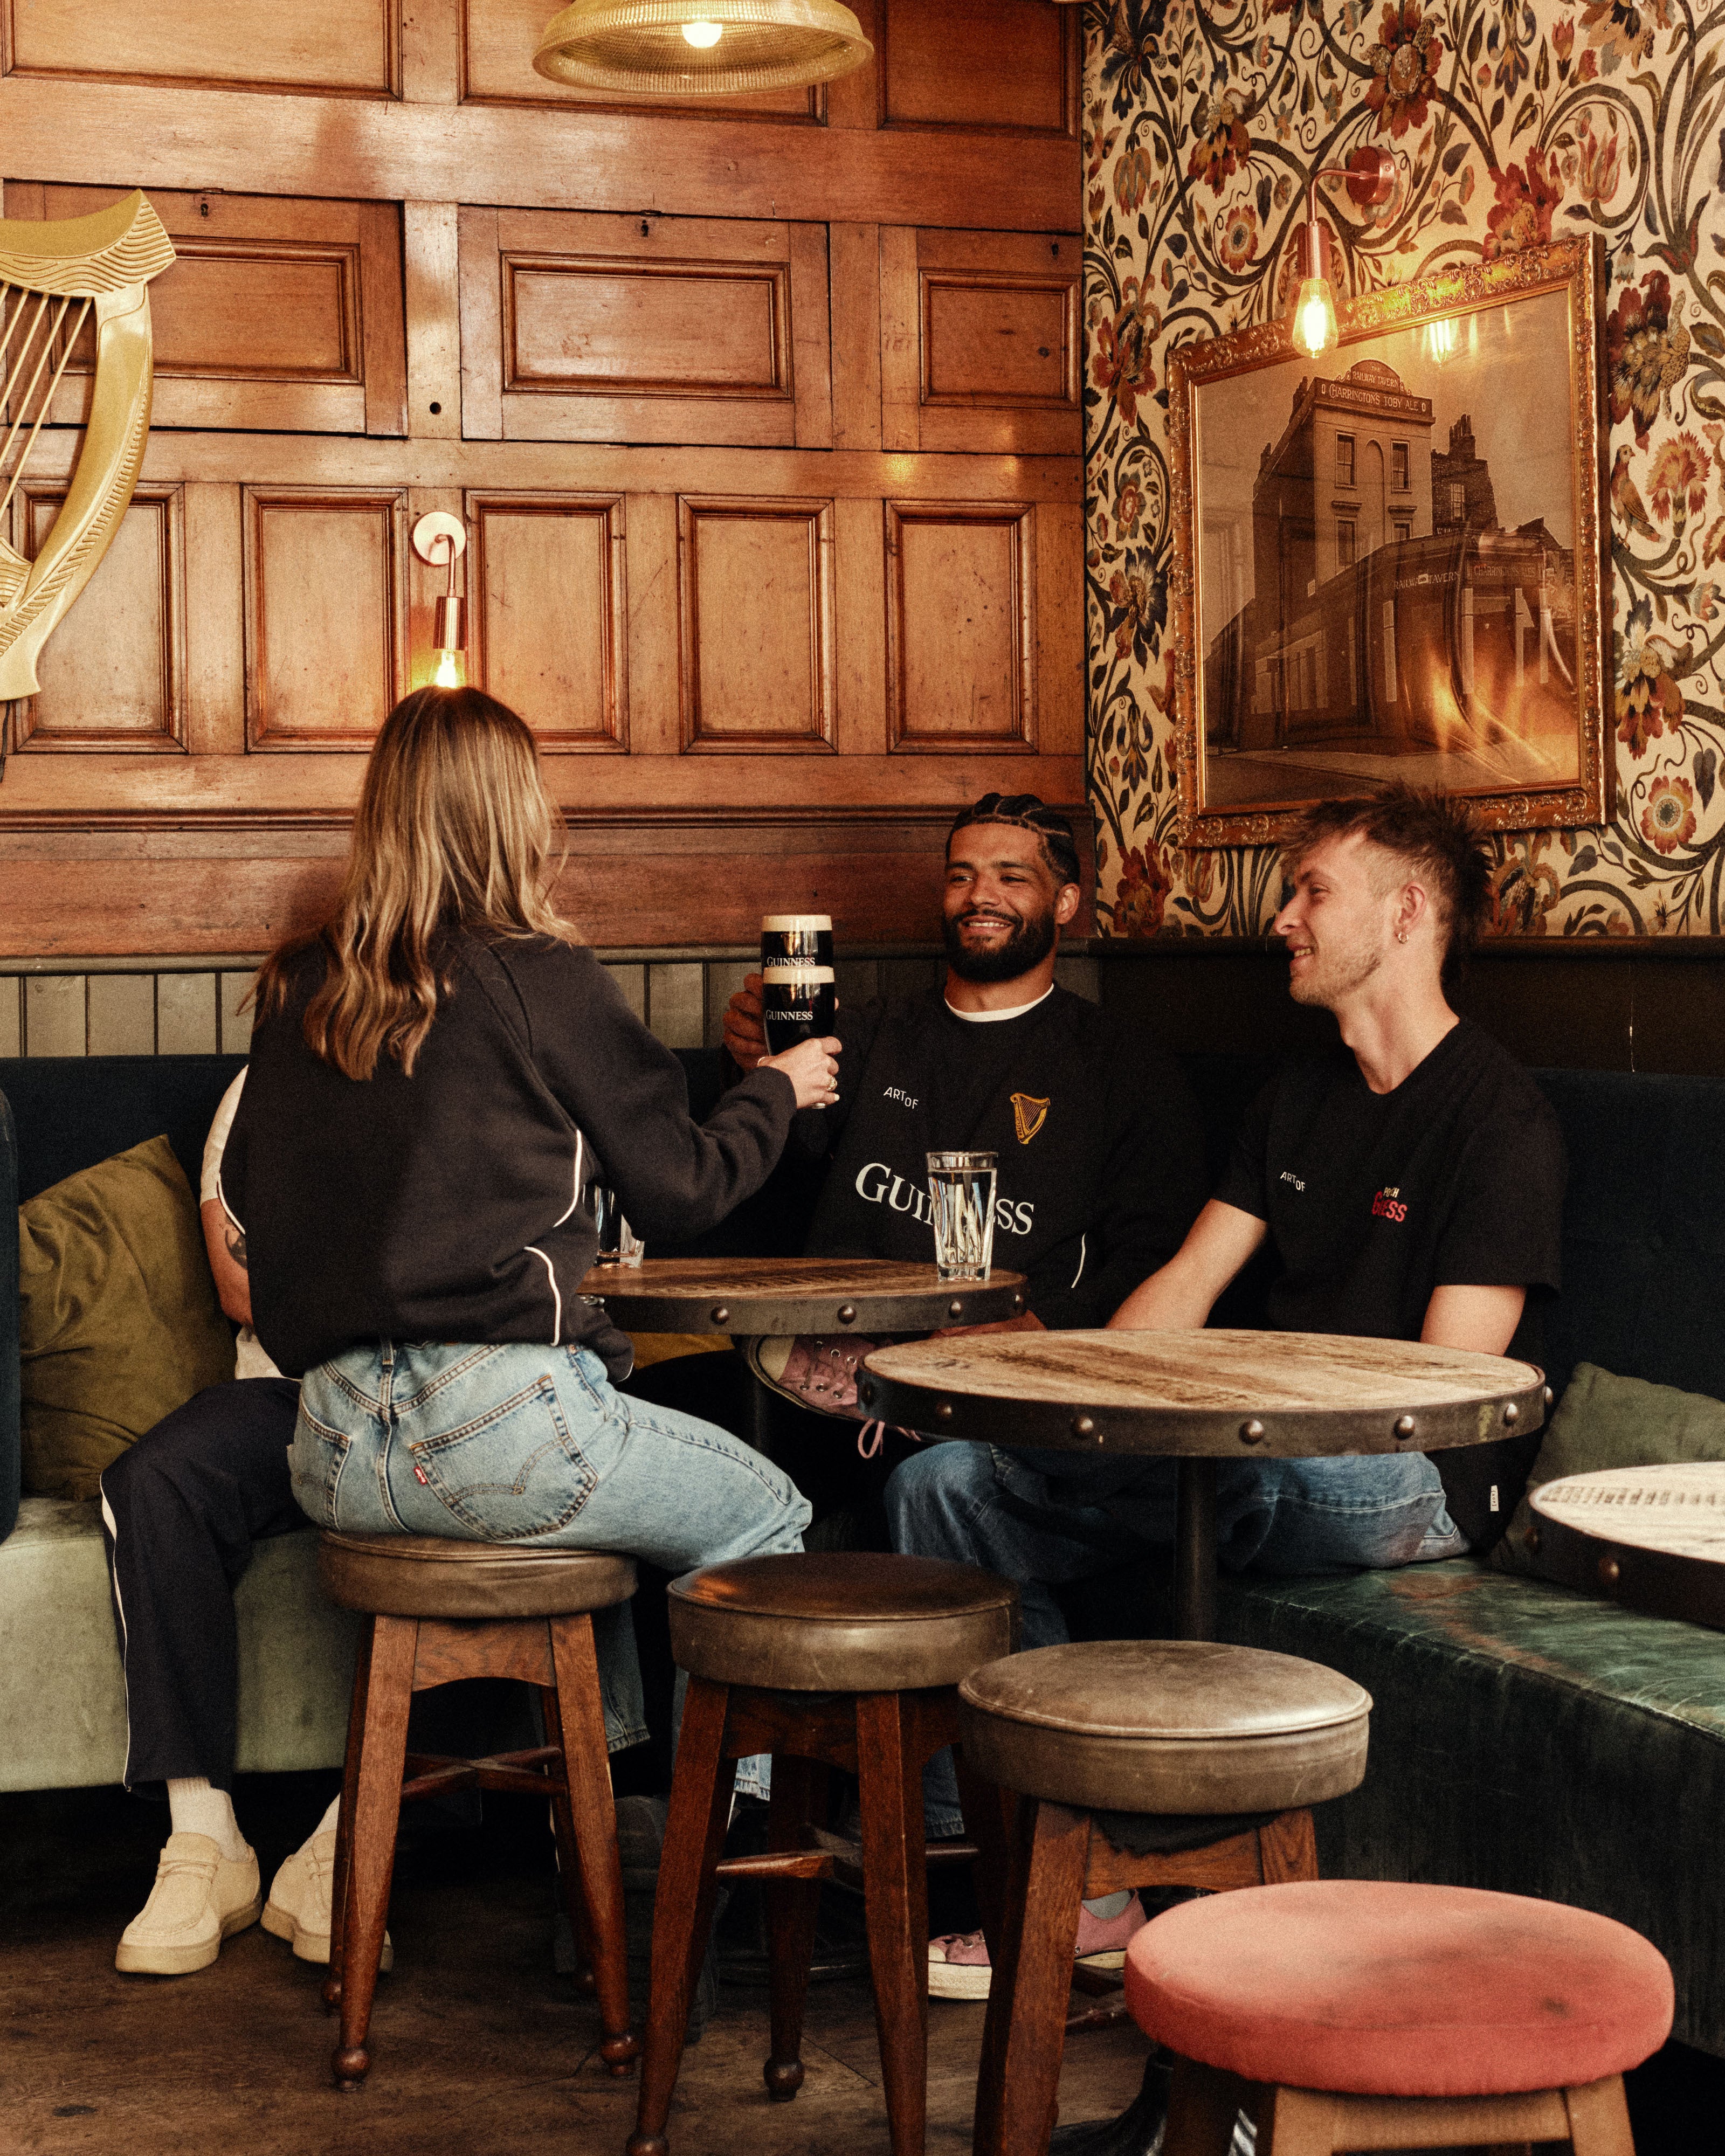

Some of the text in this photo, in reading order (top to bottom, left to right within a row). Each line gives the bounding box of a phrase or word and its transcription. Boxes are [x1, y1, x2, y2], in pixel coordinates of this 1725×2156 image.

[1353, 371, 1398, 388] RAILWAY TAVERN
[1384, 396, 1402, 409] TOBY
[1405, 399, 1419, 411] ALE
[1395, 577, 1419, 590] RAILWA
[767, 956, 816, 967] GUINNESS
[765, 1009, 813, 1020] GUINNESS
[855, 1163, 1034, 1235] GUISS
